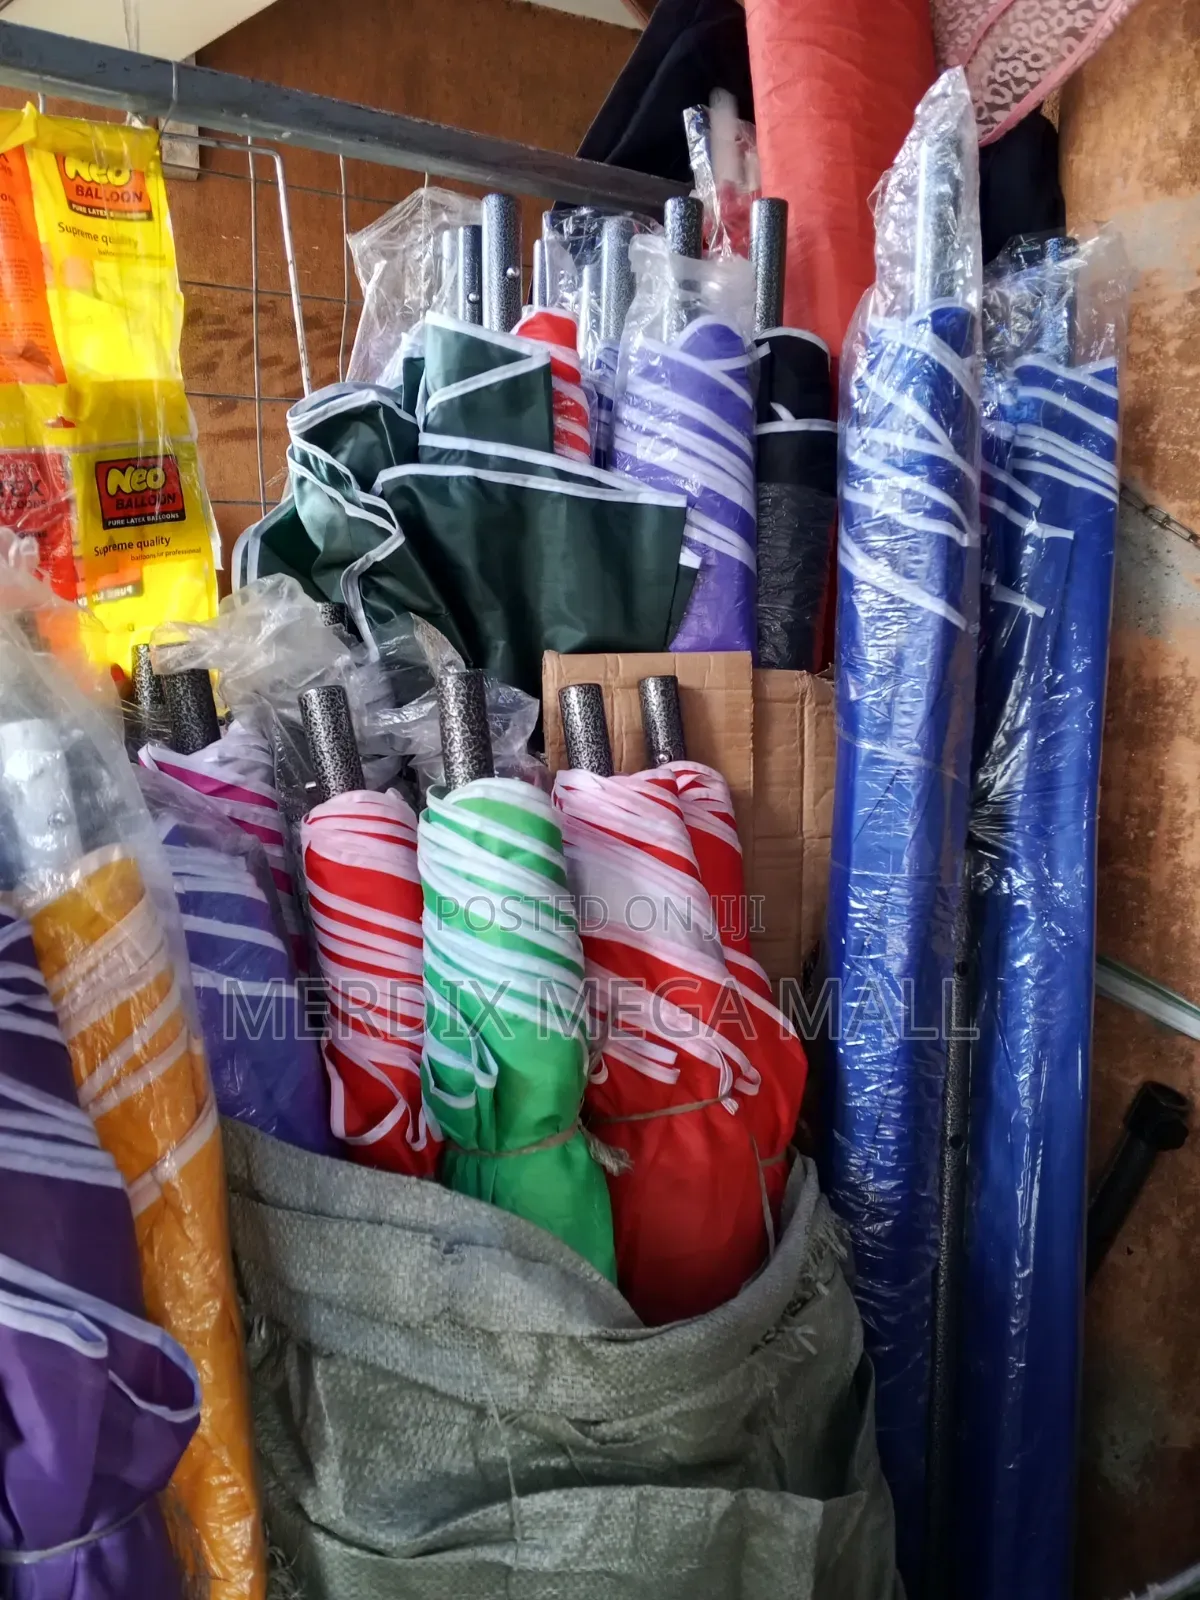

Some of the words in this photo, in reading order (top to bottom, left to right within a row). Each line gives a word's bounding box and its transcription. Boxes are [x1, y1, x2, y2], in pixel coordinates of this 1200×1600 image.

[75, 184, 143, 203] BALOON
[58, 221, 99, 243] Supreme
[106, 464, 166, 498] Neo
[115, 492, 177, 511] BALLOON
[107, 518, 125, 526] PURE
[126, 516, 146, 525] LATEX
[94, 540, 134, 557] Supreme
[136, 535, 171, 551] quality
